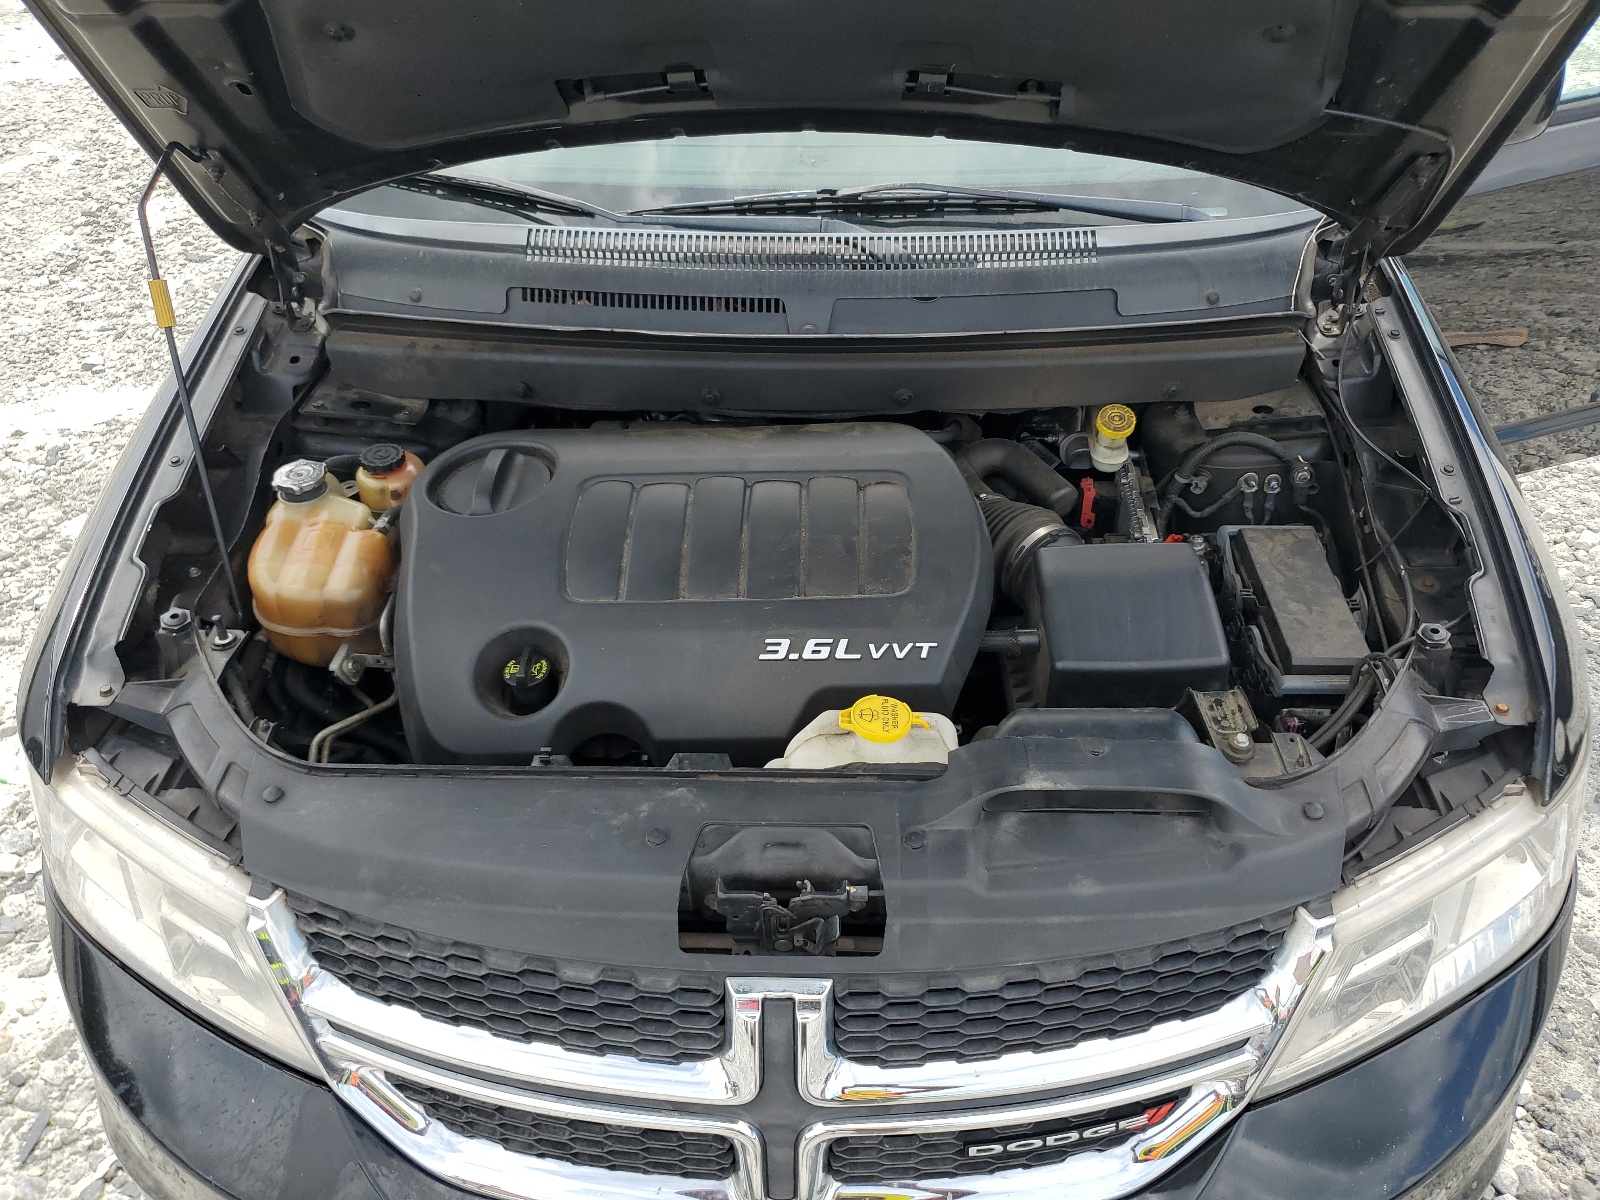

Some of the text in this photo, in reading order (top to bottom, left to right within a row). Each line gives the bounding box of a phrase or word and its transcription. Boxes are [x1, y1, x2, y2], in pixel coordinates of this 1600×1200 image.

[758, 638, 938, 661] 3.6L VVT
[881, 698, 891, 733] FLUID ONLY
[890, 702, 899, 729] WASHER
[968, 1114, 1149, 1157] DODGE
